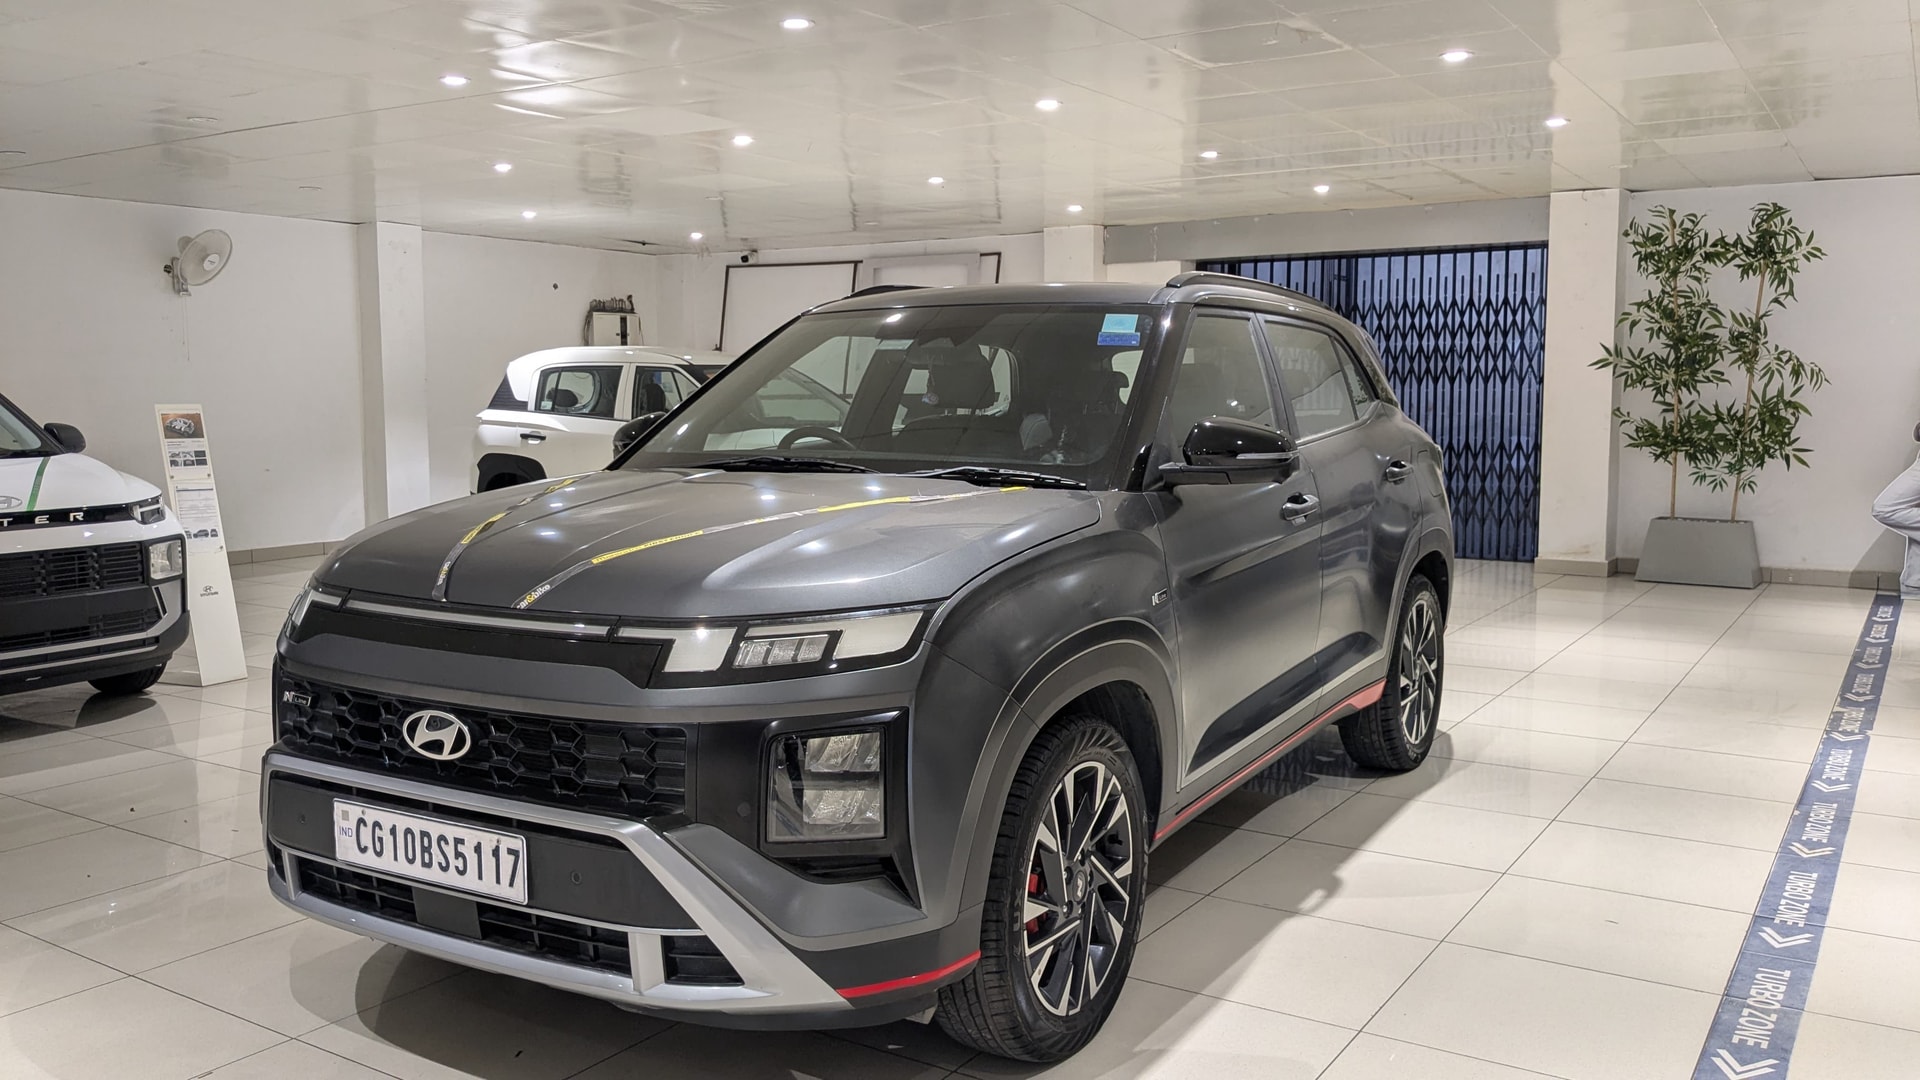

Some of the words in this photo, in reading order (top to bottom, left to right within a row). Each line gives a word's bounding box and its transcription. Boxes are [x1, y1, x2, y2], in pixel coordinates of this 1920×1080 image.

[1807, 801, 1838, 824] TURBO
[339, 825, 353, 838] IND
[1801, 822, 1832, 844] ZONE
[355, 816, 521, 888] CG10BS5117
[1782, 870, 1818, 901] TURBO
[1773, 898, 1810, 928] ZONE
[1746, 967, 1791, 1009] TURBO
[1731, 1007, 1778, 1049] ZONE
